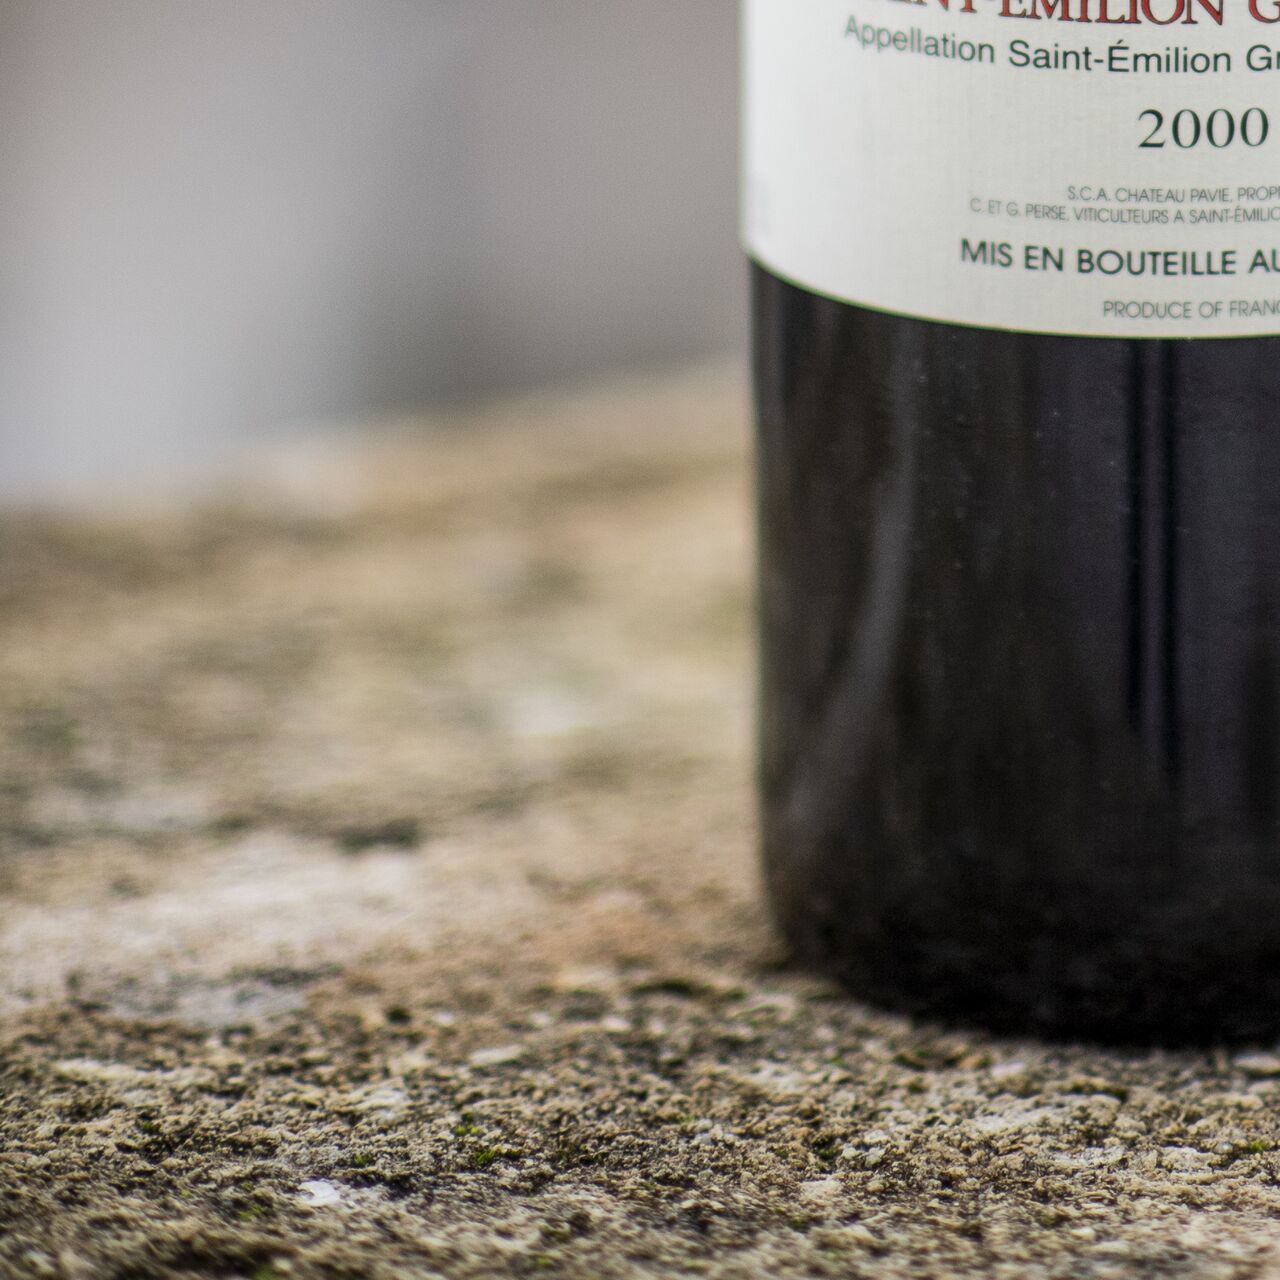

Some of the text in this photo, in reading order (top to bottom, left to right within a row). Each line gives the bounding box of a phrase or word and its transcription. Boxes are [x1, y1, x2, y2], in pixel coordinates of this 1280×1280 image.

[844, 13, 996, 65] Appellation
[1008, 40, 1232, 74] Saint-Émilion
[1137, 106, 1270, 149] 2000
[1067, 185, 1110, 202] S.C.A.
[1115, 187, 1185, 203] CHATEAU
[1190, 188, 1233, 203] PAVIE,
[988, 200, 1001, 214] ET
[1074, 206, 1169, 224] VITICULTEURS
[1173, 209, 1185, 224] A
[960, 238, 1013, 268] MIS
[1024, 245, 1065, 271] EN
[1077, 249, 1237, 276] BOUTEILLE
[1103, 301, 1193, 320] PRODUCE
[1199, 301, 1224, 319] OF
